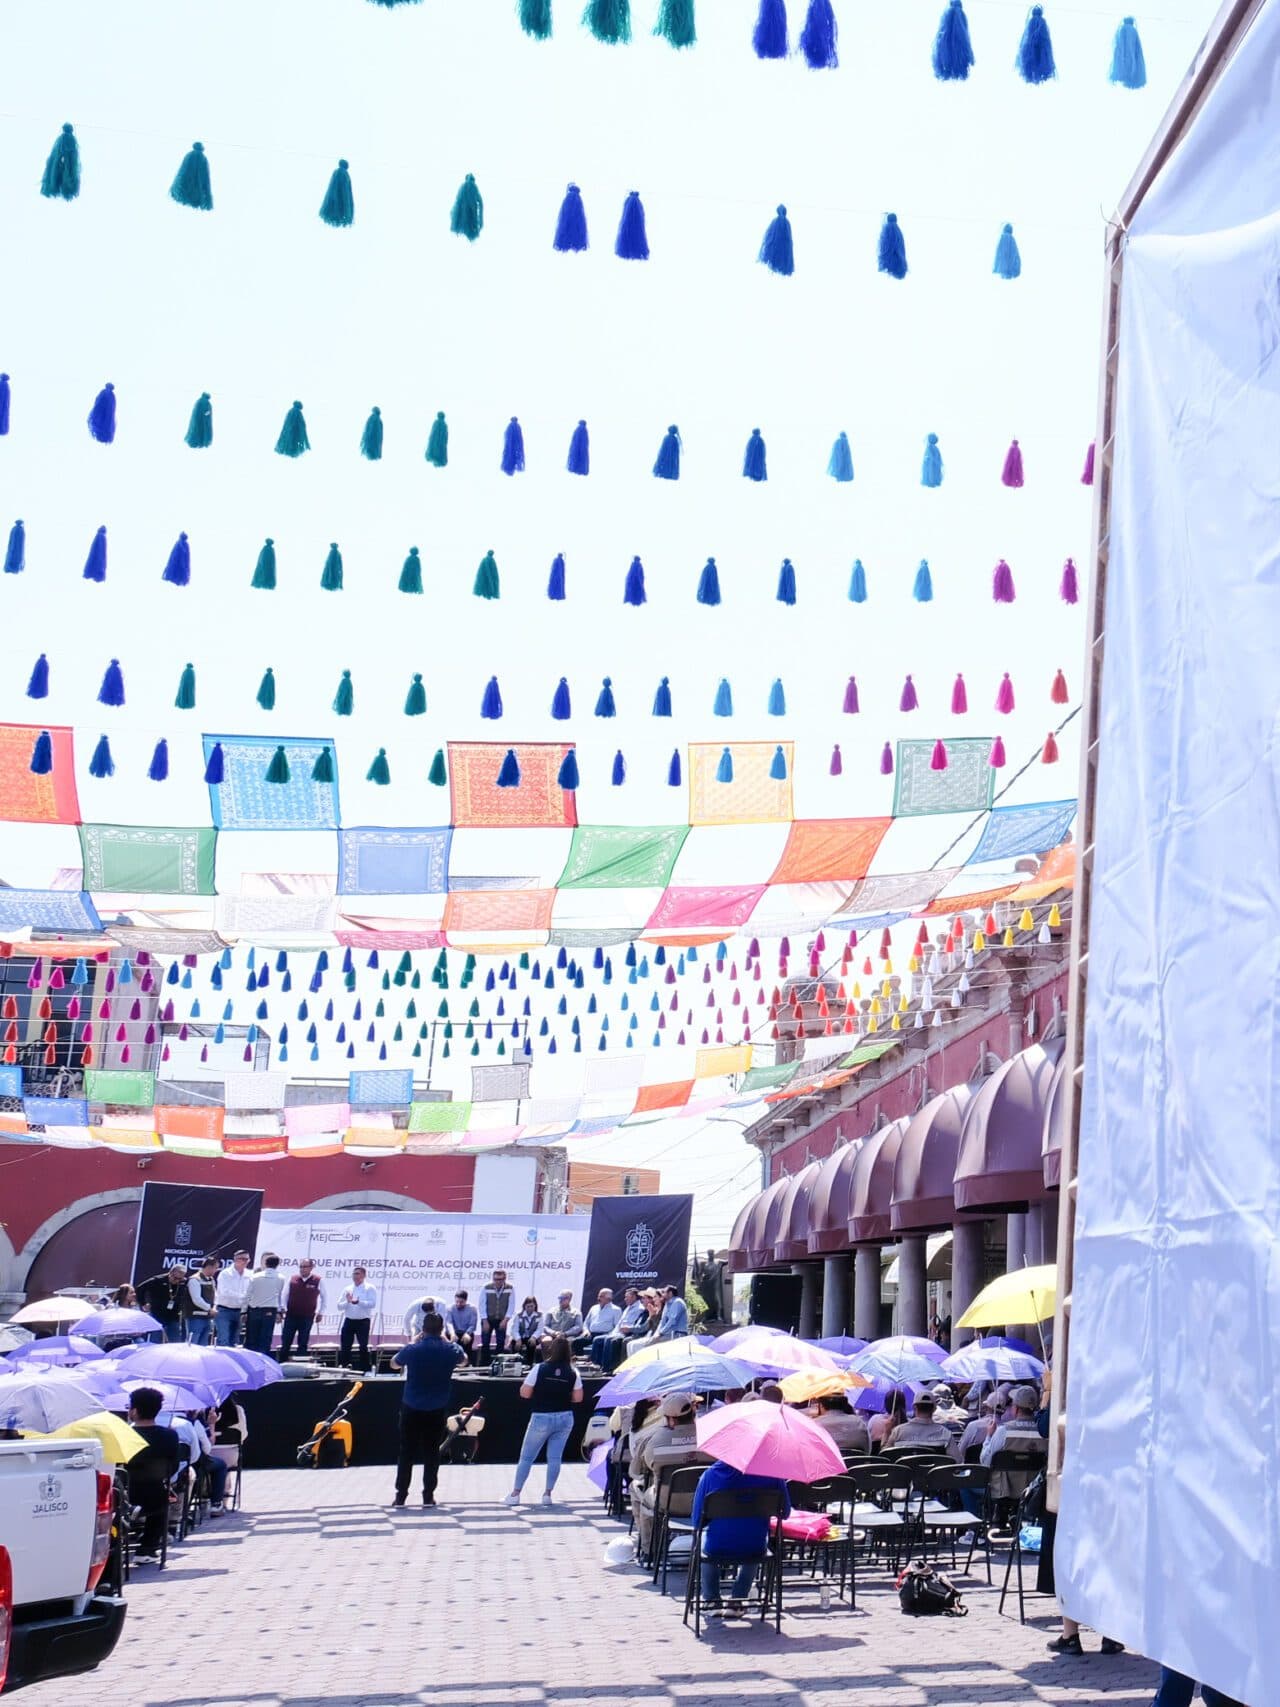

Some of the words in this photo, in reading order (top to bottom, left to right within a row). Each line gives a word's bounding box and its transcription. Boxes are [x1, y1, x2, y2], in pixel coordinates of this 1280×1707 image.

[334, 1258, 417, 1268] INTERESTATAL
[419, 1259, 433, 1269] DE
[436, 1260, 494, 1269] ACCIONES
[497, 1261, 572, 1270] SIMULTANEAS
[325, 1270, 342, 1279] EN
[367, 1270, 401, 1280] UCHA
[402, 1270, 451, 1280] CONTRA
[453, 1271, 465, 1280] EL
[468, 1271, 514, 1280] DENE
[32, 1502, 69, 1514] JALISCO
